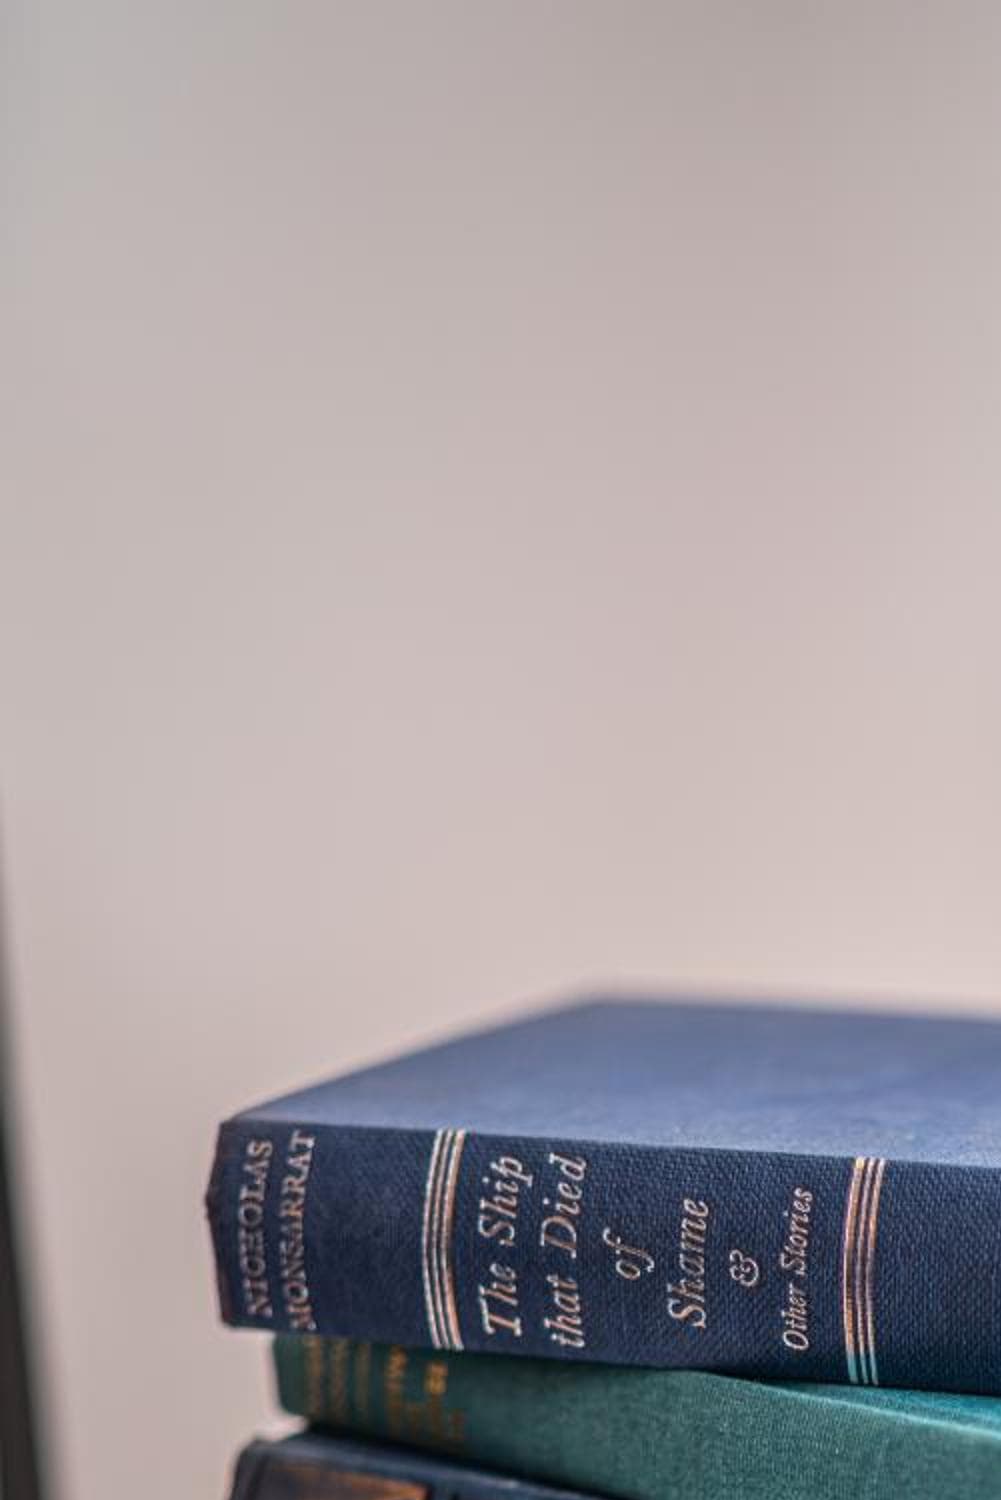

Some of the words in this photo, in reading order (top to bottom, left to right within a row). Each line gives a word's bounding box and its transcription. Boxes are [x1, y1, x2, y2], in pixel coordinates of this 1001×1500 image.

[238, 1139, 273, 1318] NICHOLAS
[280, 1130, 316, 1332] MONSARRAT
[478, 1156, 532, 1246] Ship
[539, 1152, 588, 1259] Died
[780, 1187, 813, 1270] Stories
[483, 1248, 521, 1337] The
[602, 1227, 655, 1281] of
[667, 1197, 713, 1327] Shame
[730, 1249, 759, 1287] &
[543, 1274, 586, 1349] that
[782, 1274, 811, 1352] Other
